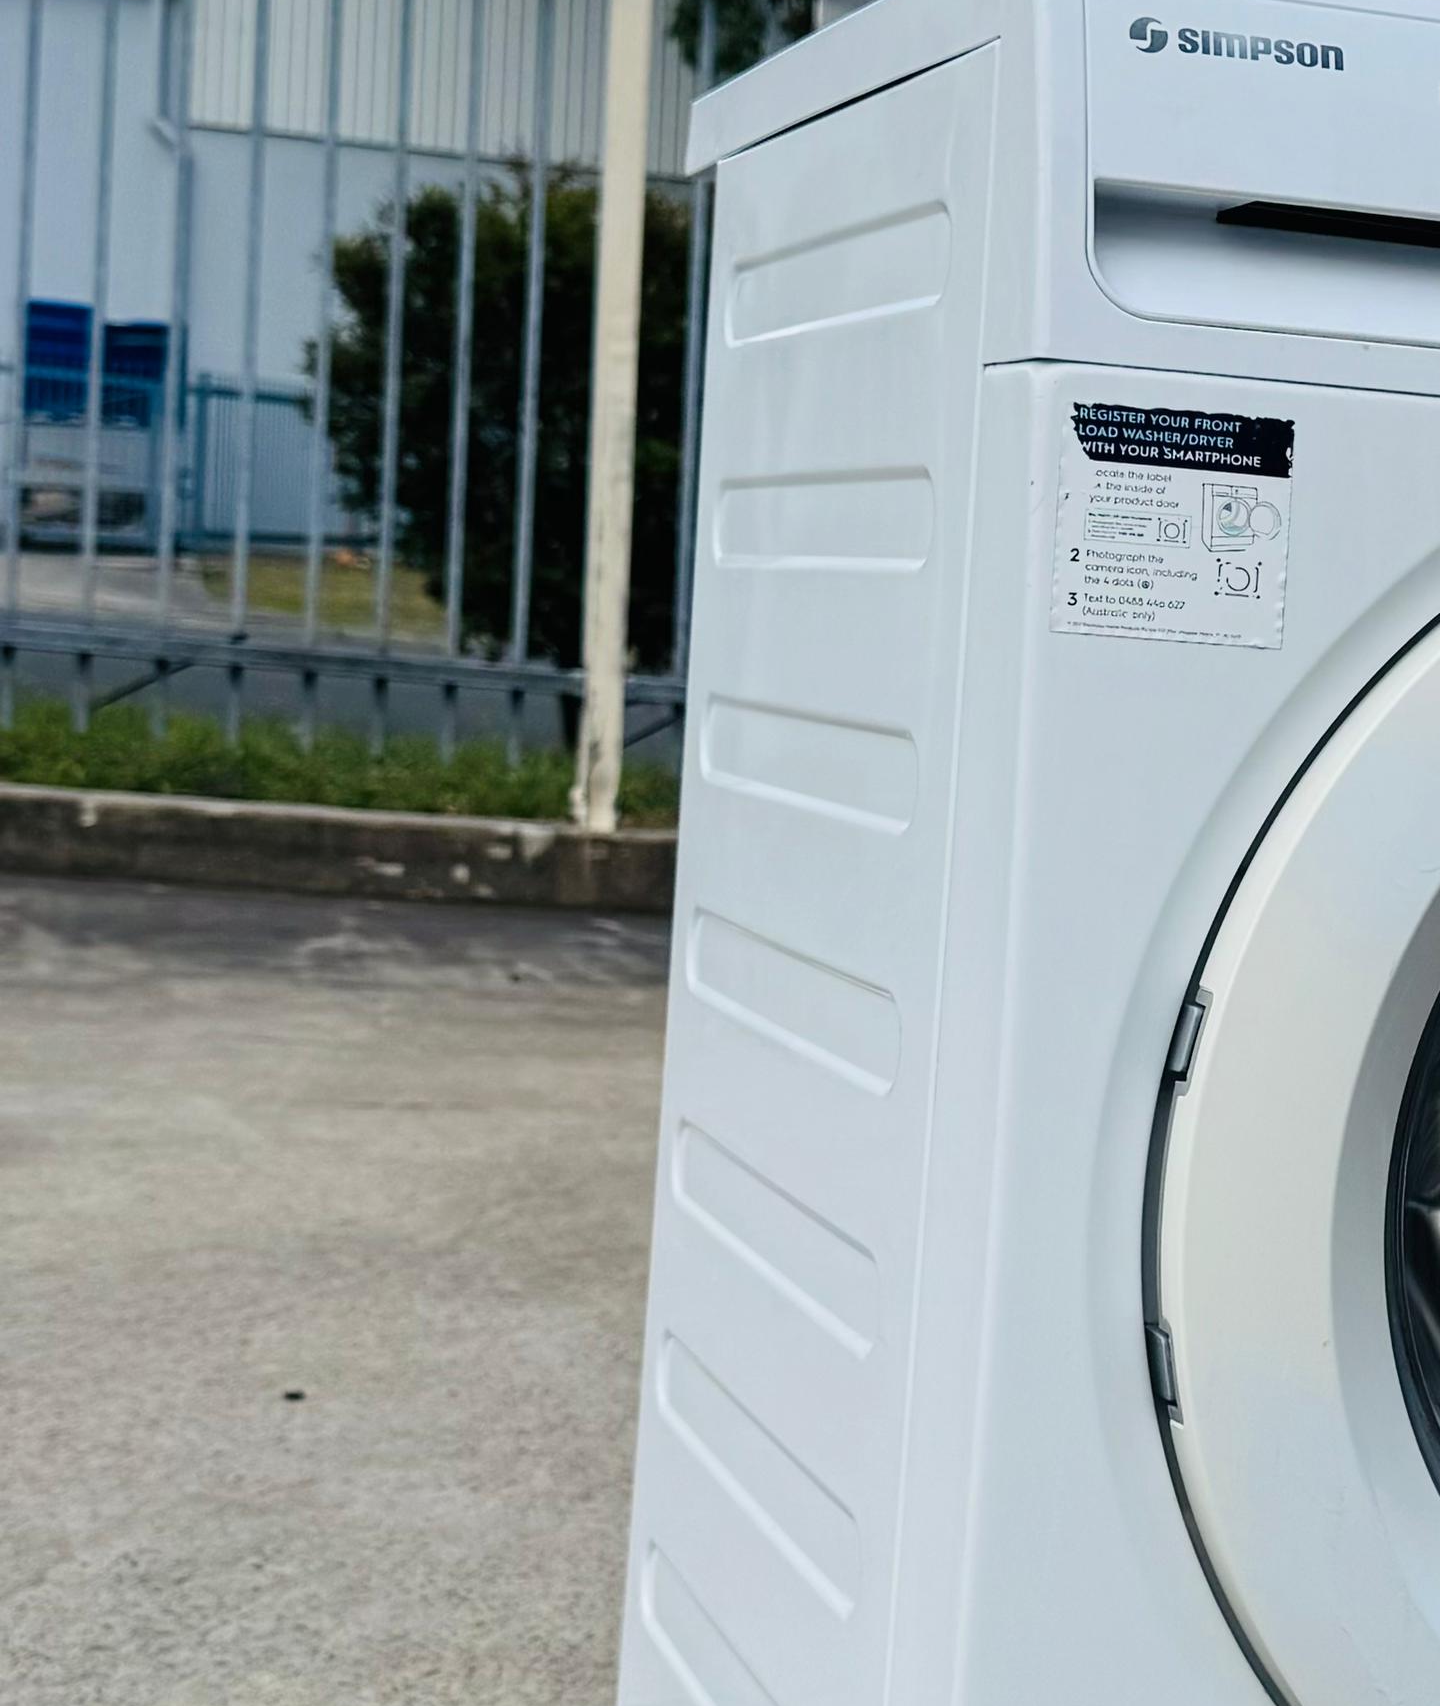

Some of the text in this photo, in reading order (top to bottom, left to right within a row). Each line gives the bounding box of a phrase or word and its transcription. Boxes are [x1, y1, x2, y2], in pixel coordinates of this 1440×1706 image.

[1177, 27, 1344, 71] SIMPSON
[1080, 407, 1242, 433] REGISTER YOUR FRONT
[1079, 423, 1234, 449] LOAD WASHER/DRYER
[1082, 441, 1262, 468] WITH YOUR SMARTPHONE
[1070, 548, 1080, 562] 2
[1067, 592, 1078, 606] 3
